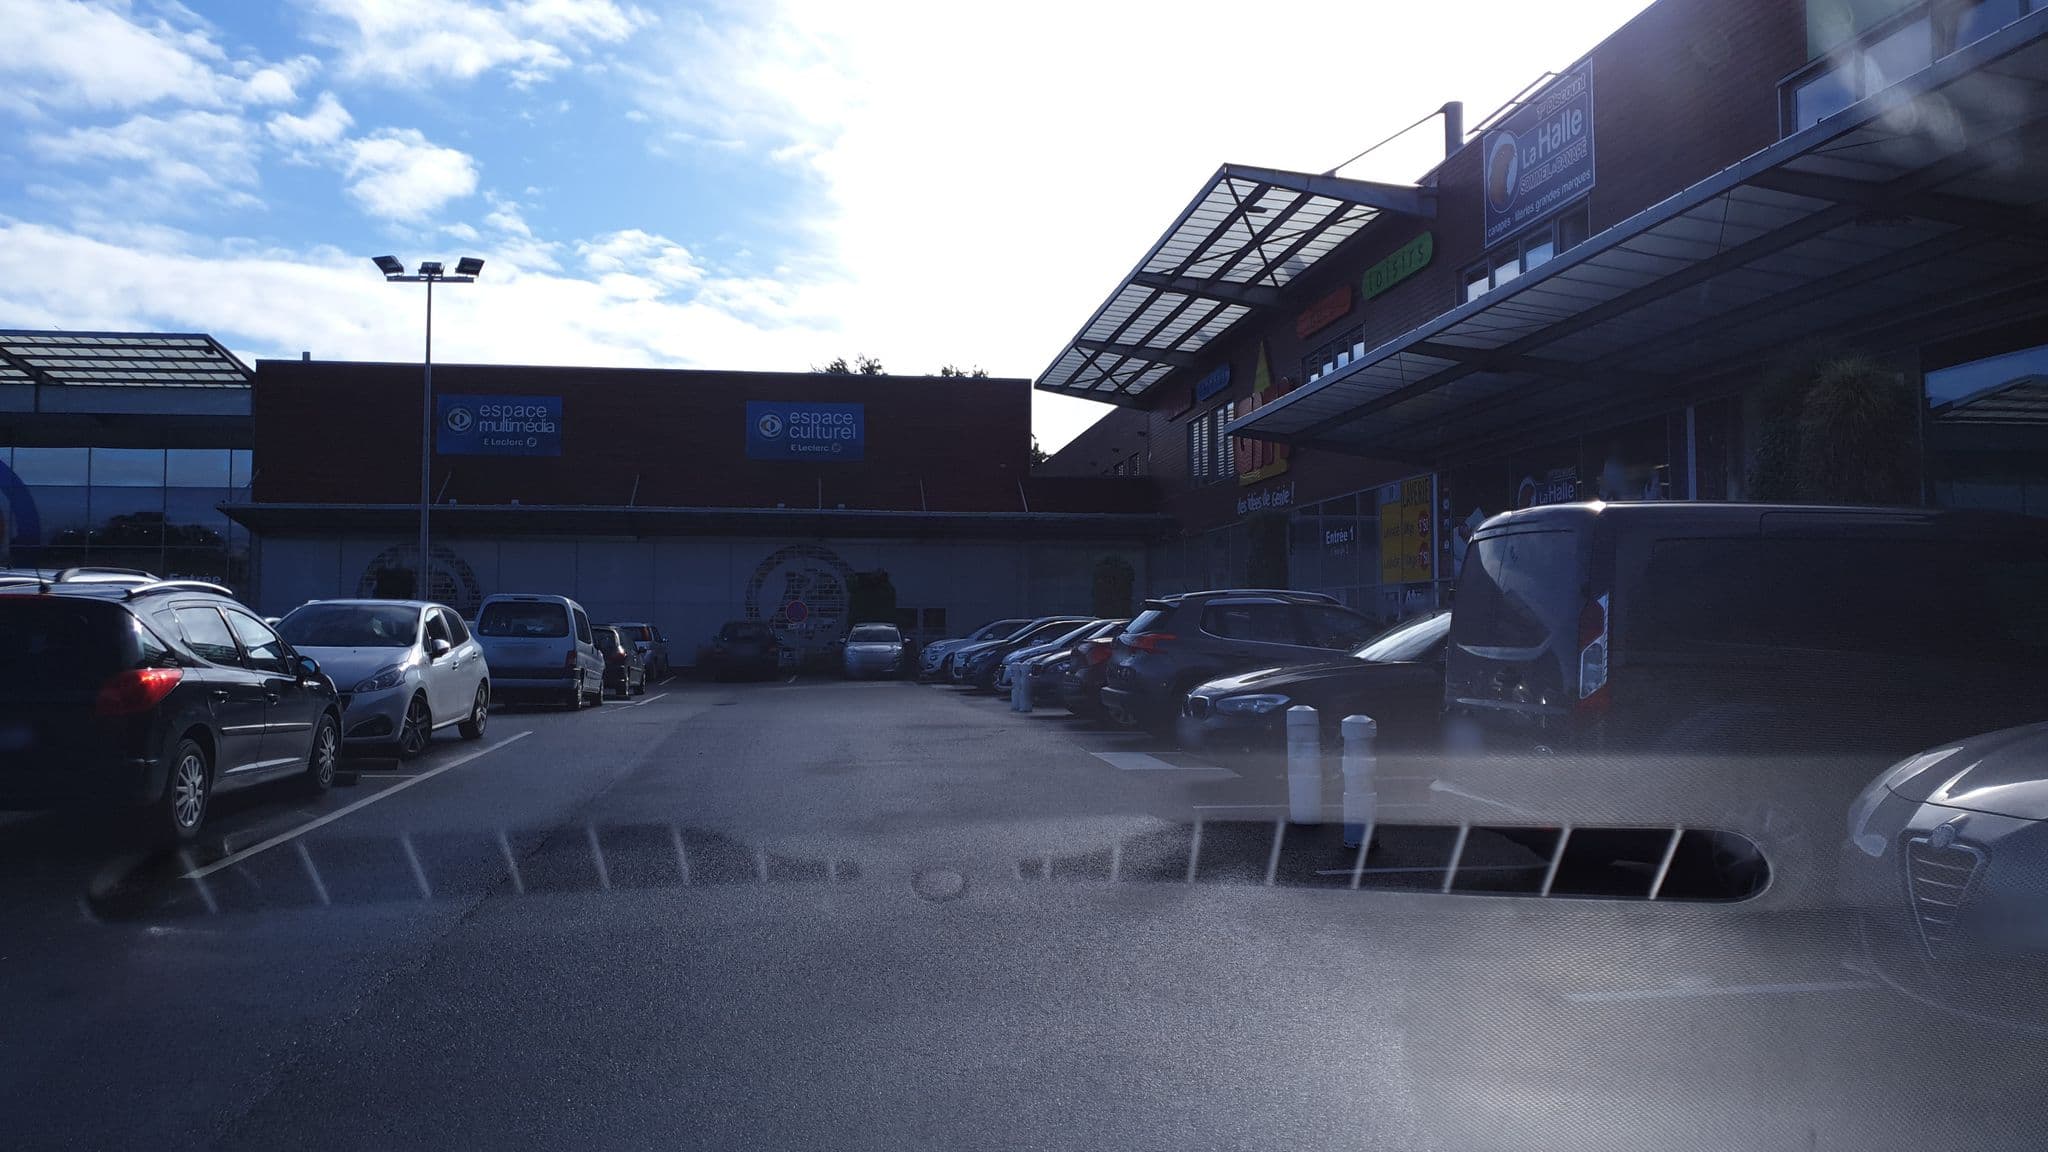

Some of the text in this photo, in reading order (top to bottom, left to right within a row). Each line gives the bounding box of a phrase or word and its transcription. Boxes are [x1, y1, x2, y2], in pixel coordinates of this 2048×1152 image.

[1522, 108, 1582, 169] La Halle
[1562, 169, 1592, 195] marques
[479, 404, 547, 422] espace
[789, 411, 853, 430] espace
[479, 418, 555, 433] multimédia
[789, 424, 856, 440] culturel
